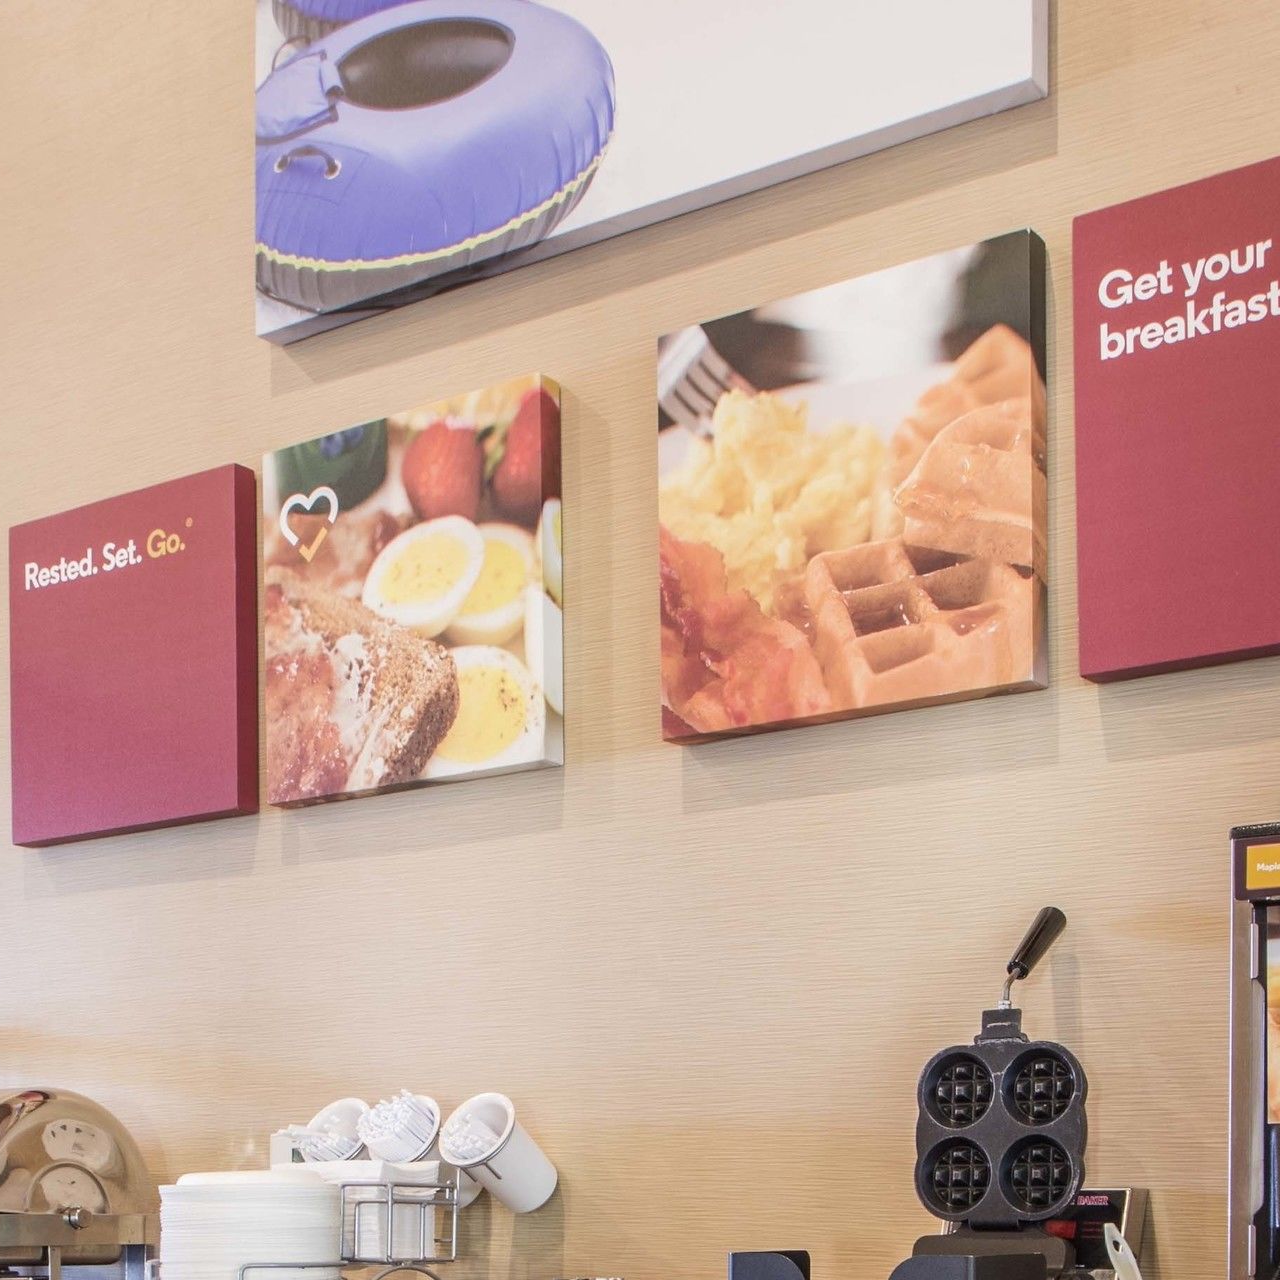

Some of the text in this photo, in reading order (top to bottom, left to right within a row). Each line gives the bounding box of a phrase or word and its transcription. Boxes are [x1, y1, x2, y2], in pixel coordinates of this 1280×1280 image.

[1098, 238, 1273, 308] Get your
[24, 547, 99, 591] Rested.
[102, 539, 143, 571] Set.
